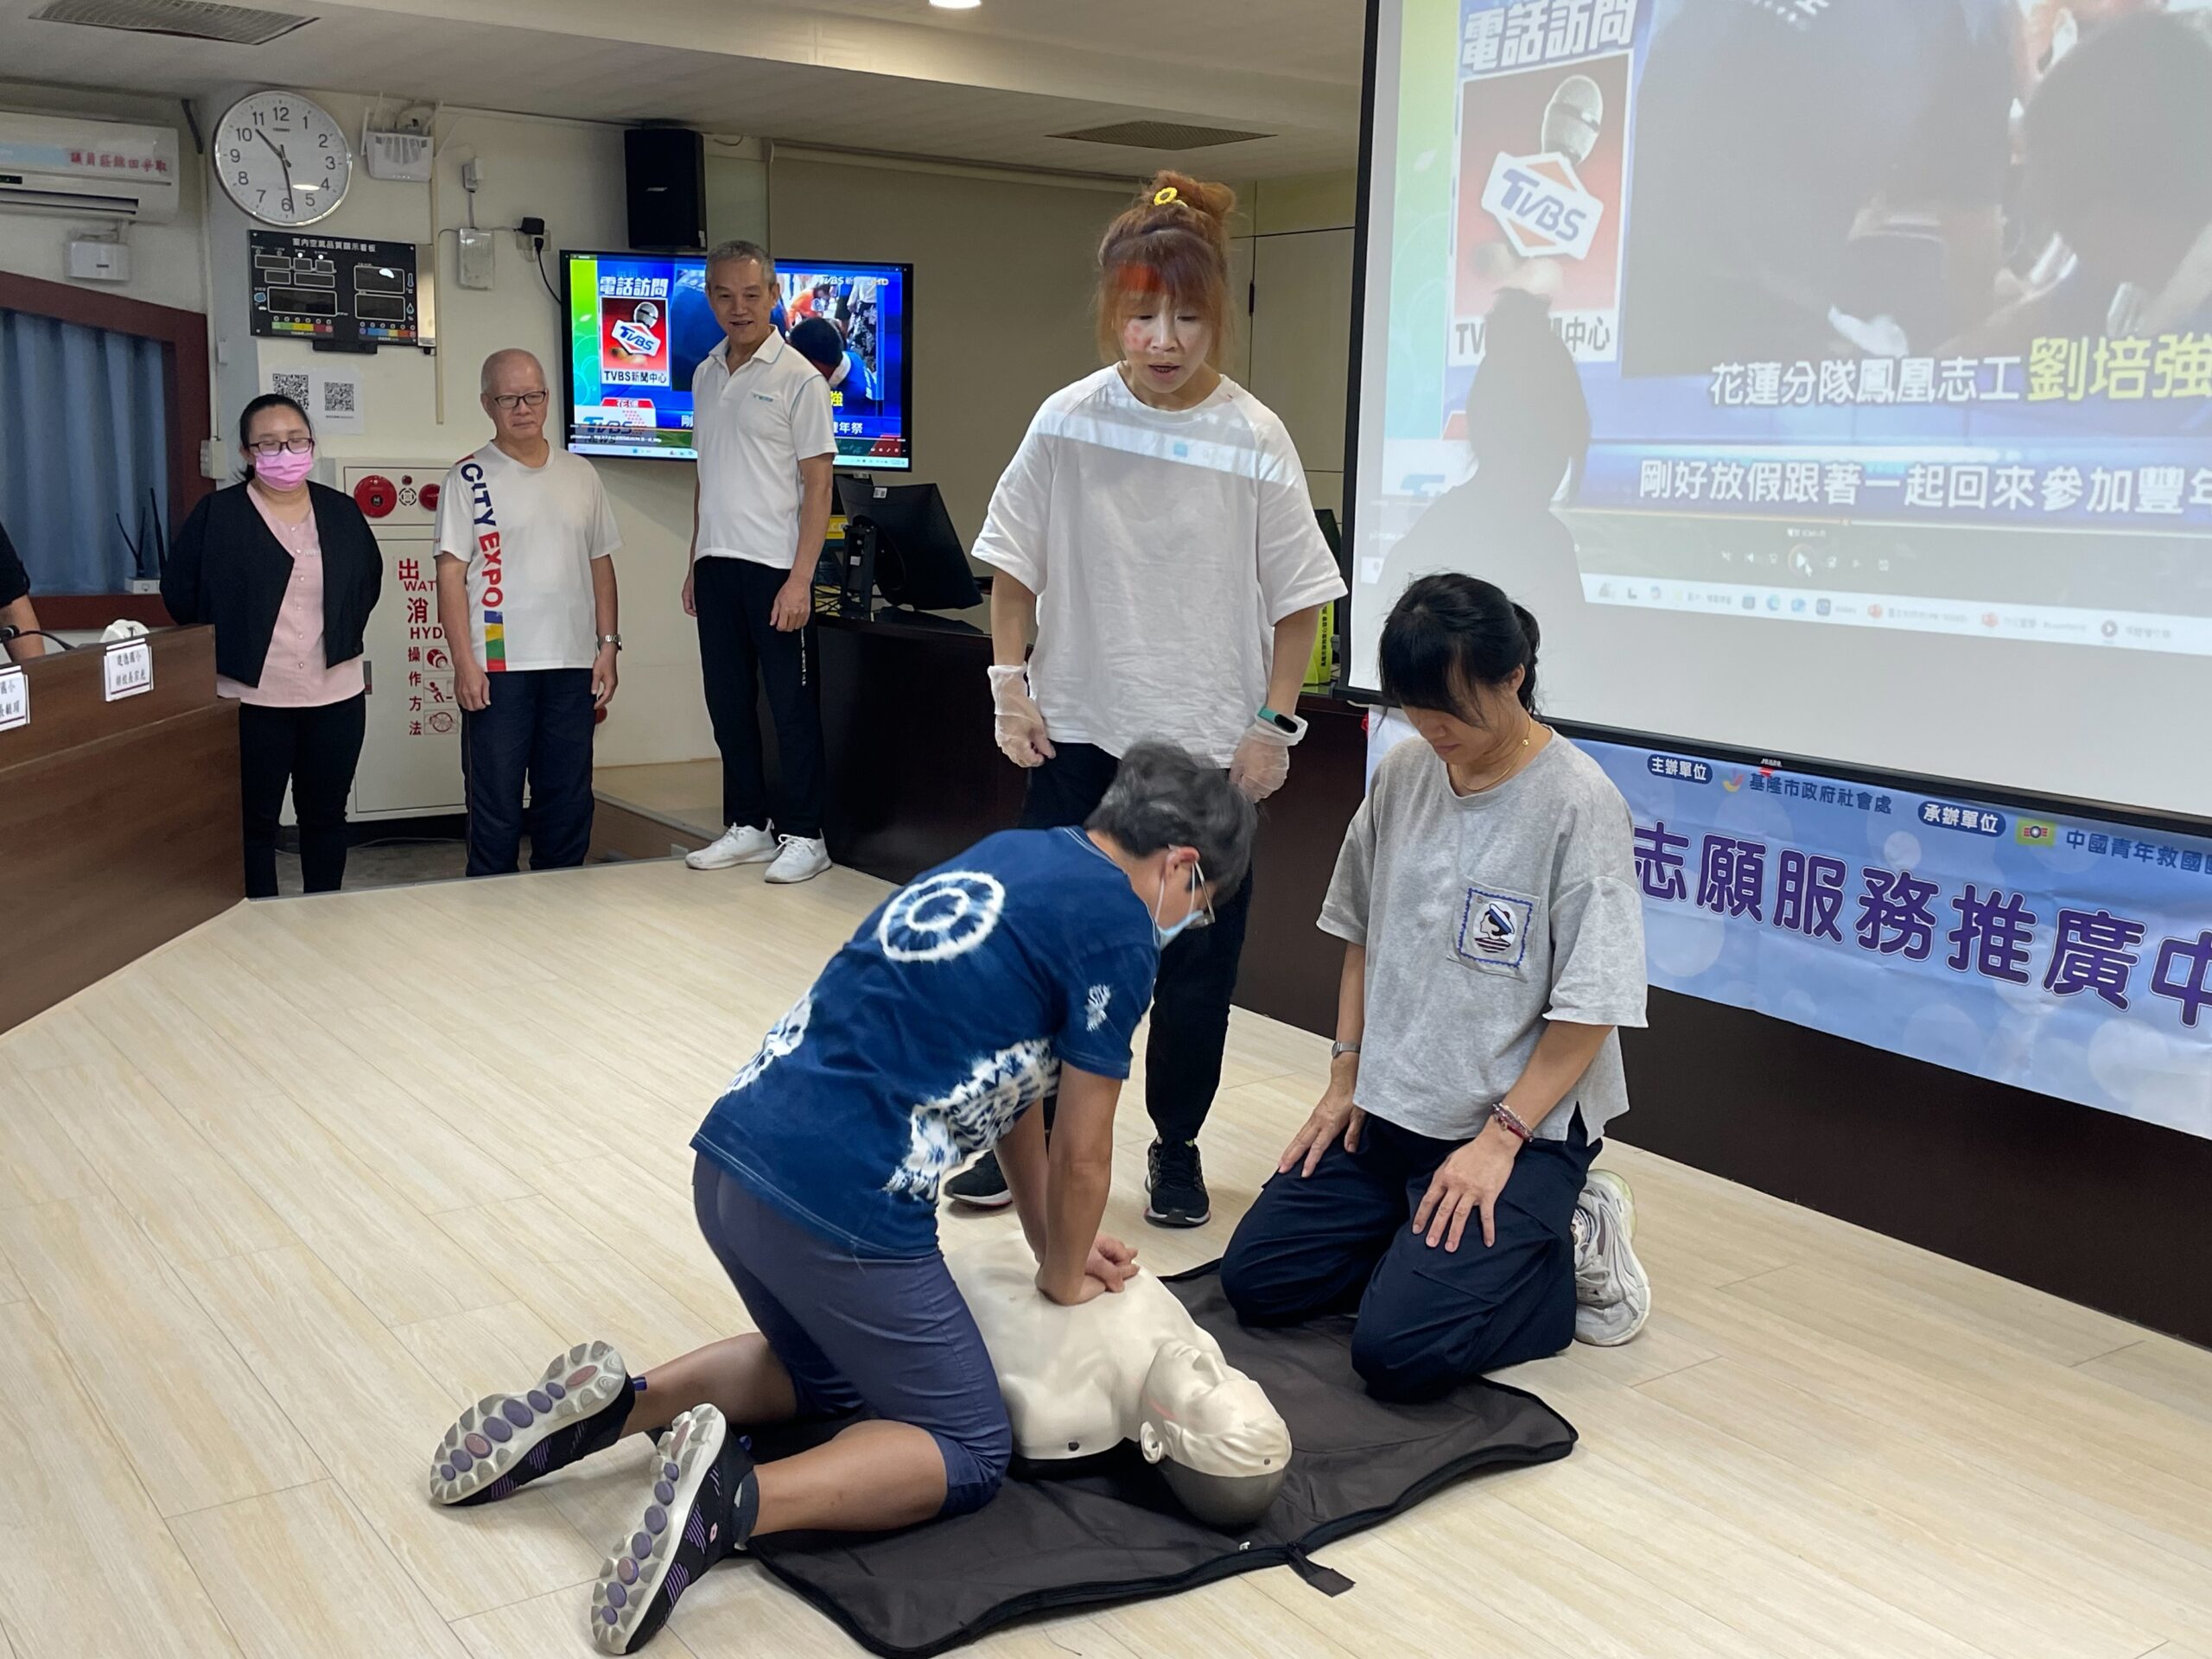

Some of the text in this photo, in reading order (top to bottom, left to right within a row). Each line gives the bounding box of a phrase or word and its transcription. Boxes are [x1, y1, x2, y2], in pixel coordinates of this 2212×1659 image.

[1462, 0, 1637, 71] 電話訪問
[251, 111, 264, 126] 11
[273, 106, 289, 121] 12
[302, 115, 308, 130] 1
[236, 128, 252, 142] 10
[318, 133, 328, 148] 2
[230, 149, 240, 163] 9
[325, 156, 336, 170] 3
[238, 171, 249, 186] 8
[320, 177, 330, 191] 4
[256, 189, 266, 203] 7
[305, 193, 315, 207] 5
[281, 198, 292, 212] 6
[1501, 168, 1586, 242] TVBS
[600, 276, 669, 297] 電話訪問
[620, 325, 654, 351] TVBS
[1710, 332, 2212, 406] 花蓮分隊鳳凰志工 劉培強
[604, 370, 667, 384] TVBS新聞中心
[461, 463, 504, 607] CITY EXPO
[404, 581, 437, 592] WAT
[410, 626, 446, 640] HYD
[408, 646, 423, 735] 操作方法
[1651, 756, 1707, 782] 主辦單位
[1749, 772, 1892, 815] 基隆市政府社會處
[1923, 803, 1999, 834] 承辦單位
[1633, 820, 2212, 1030] 志願服務推廣中
